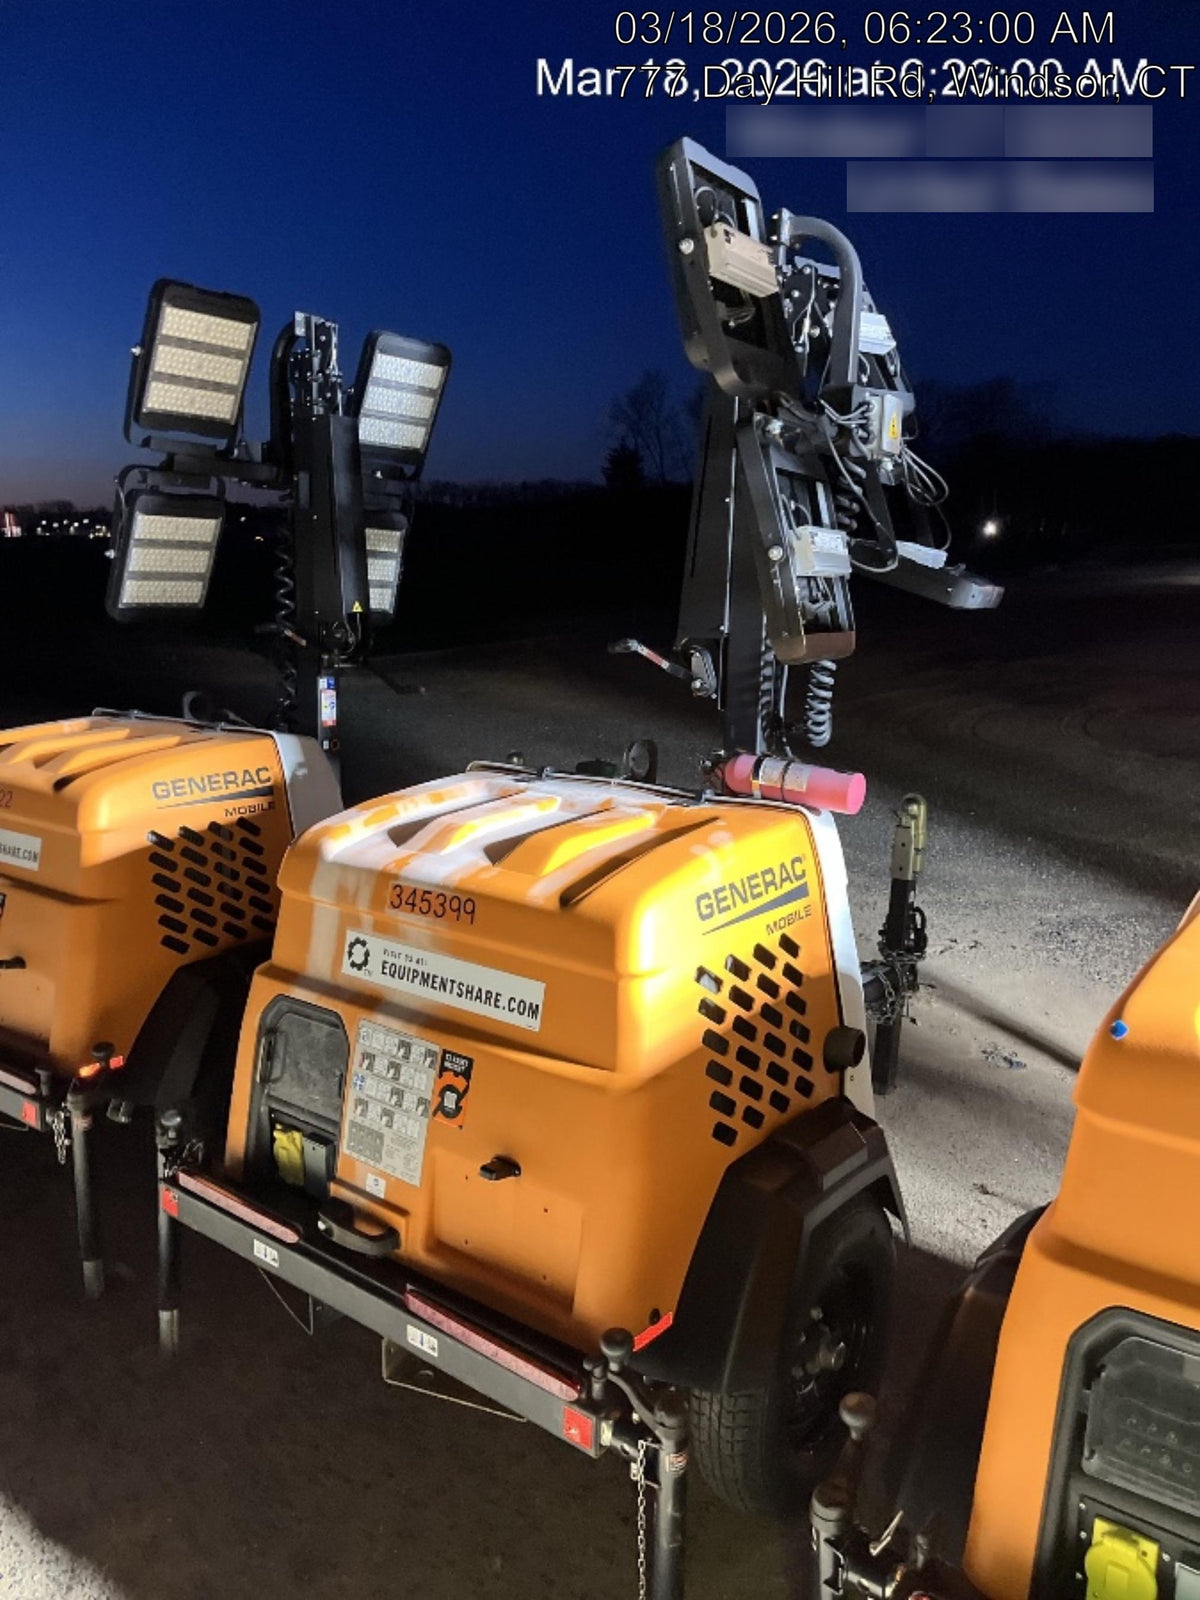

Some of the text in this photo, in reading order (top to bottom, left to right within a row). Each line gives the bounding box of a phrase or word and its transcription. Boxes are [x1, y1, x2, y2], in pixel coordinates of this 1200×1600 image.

[152, 766, 272, 800] GENERAC
[224, 800, 276, 817] MOBILE
[389, 884, 477, 926] 345399
[695, 856, 807, 922] GENERAC
[765, 904, 813, 936] MOBILE
[381, 960, 541, 1021] EQUIPMENTSHARE.COM
